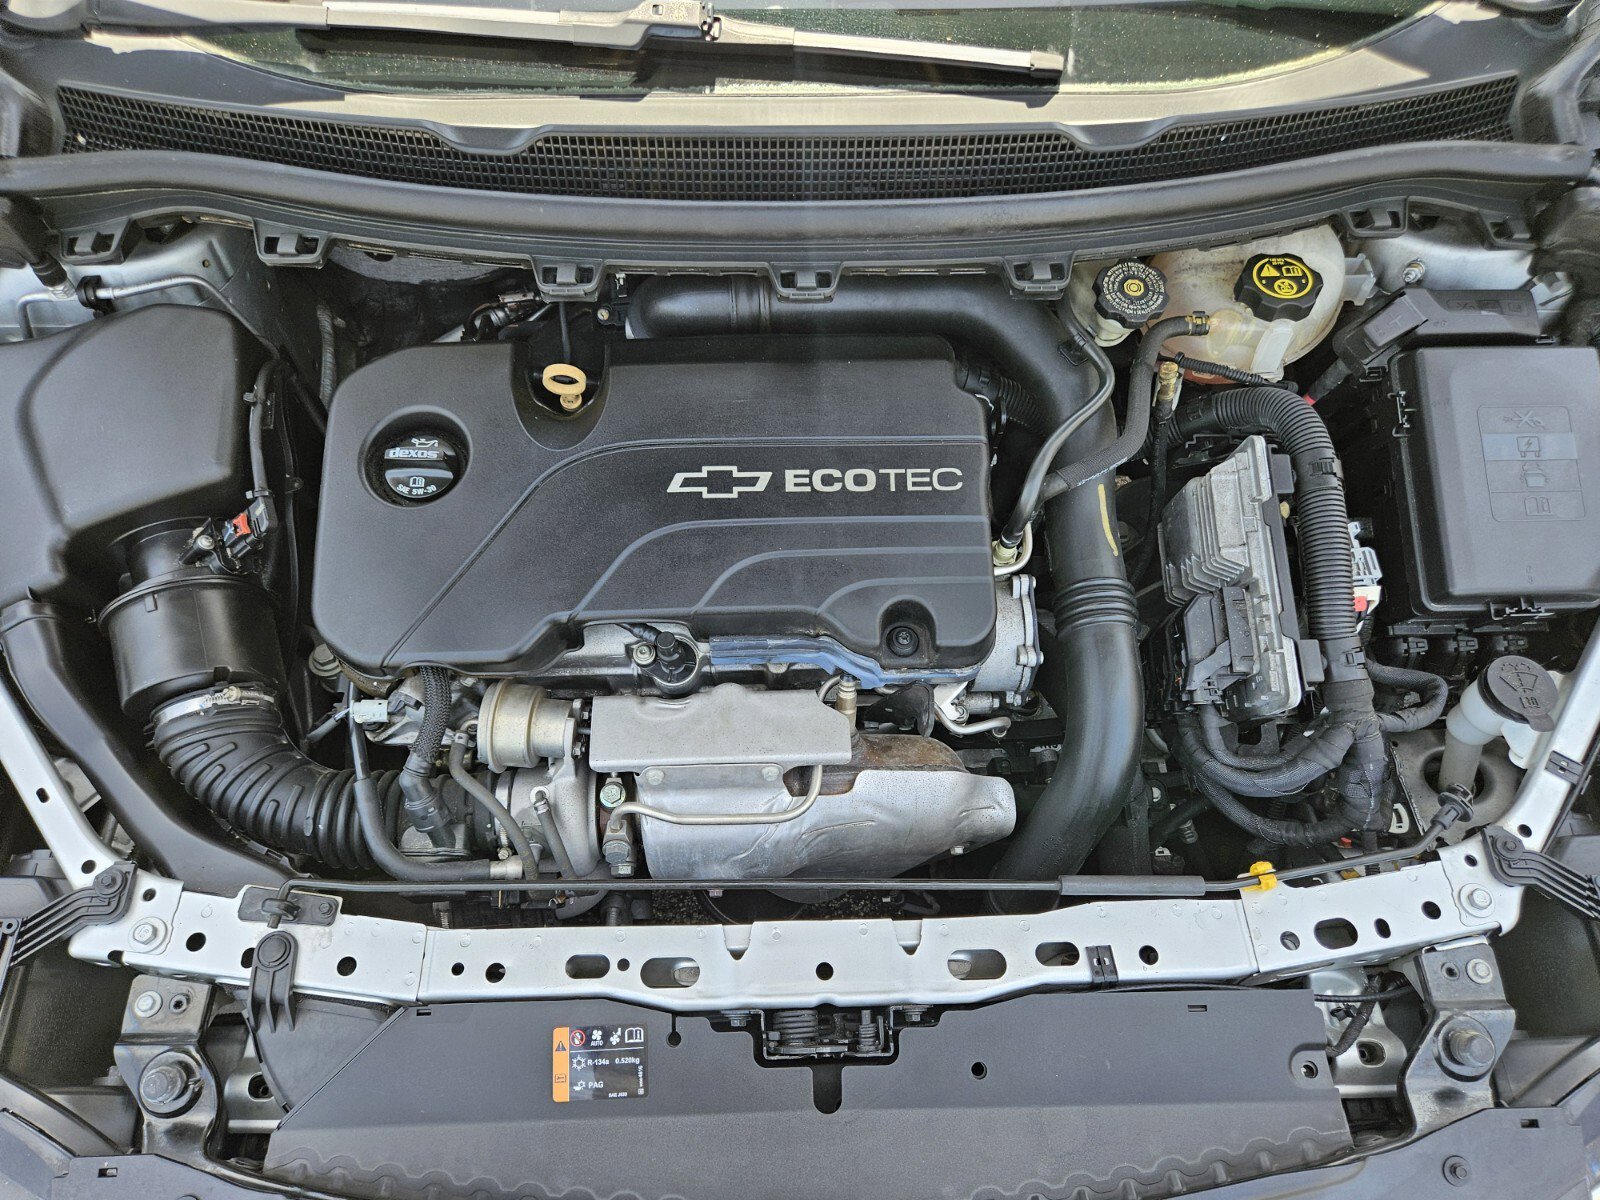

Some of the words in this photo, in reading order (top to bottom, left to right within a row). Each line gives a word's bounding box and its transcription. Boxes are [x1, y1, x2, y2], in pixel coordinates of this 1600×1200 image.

[388, 447, 440, 459] dexos
[784, 467, 964, 493] ECOTEC
[396, 483, 411, 495] SAE
[412, 485, 437, 495] 5W-30
[615, 1056, 640, 1065] 0.520kg
[588, 1081, 604, 1089] PAG
